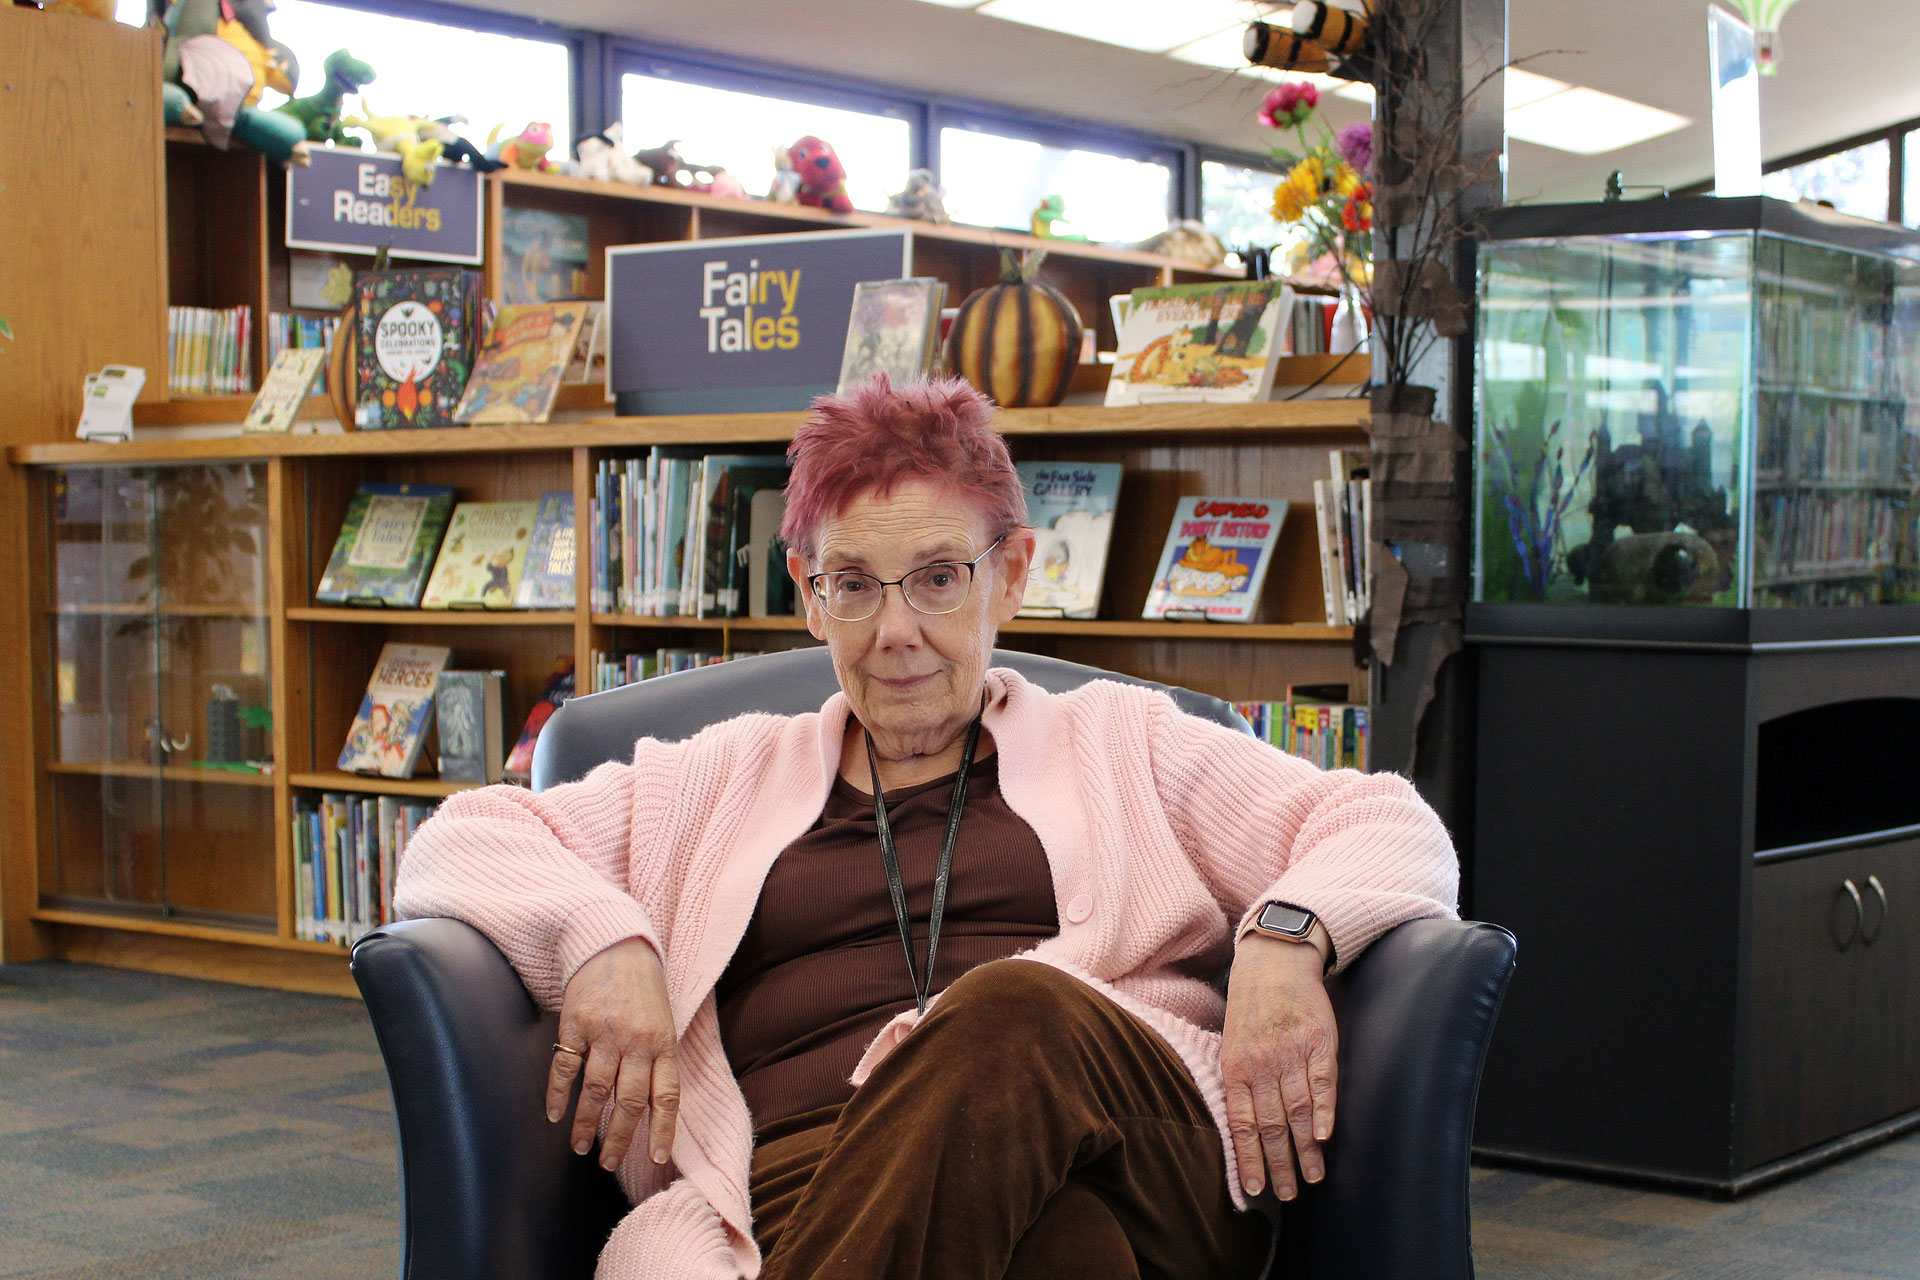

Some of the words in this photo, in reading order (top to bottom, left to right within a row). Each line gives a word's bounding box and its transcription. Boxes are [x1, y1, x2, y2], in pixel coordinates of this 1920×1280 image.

[358, 163, 419, 205] Easy
[333, 189, 442, 232] Readers
[703, 259, 801, 316] Fairy
[380, 321, 435, 338] SPOOKY
[699, 305, 800, 354] Tales
[380, 339, 436, 350] CELEBRATIONS
[1033, 482, 1093, 498] GALLERY
[469, 507, 522, 528] CHINESE
[1194, 501, 1270, 519] GARFIELD
[562, 527, 576, 539] FIR
[1220, 520, 1271, 540] DISTURB
[549, 549, 575, 562] FAIRY
[547, 560, 573, 576] TALES
[377, 666, 435, 687] HEROES
